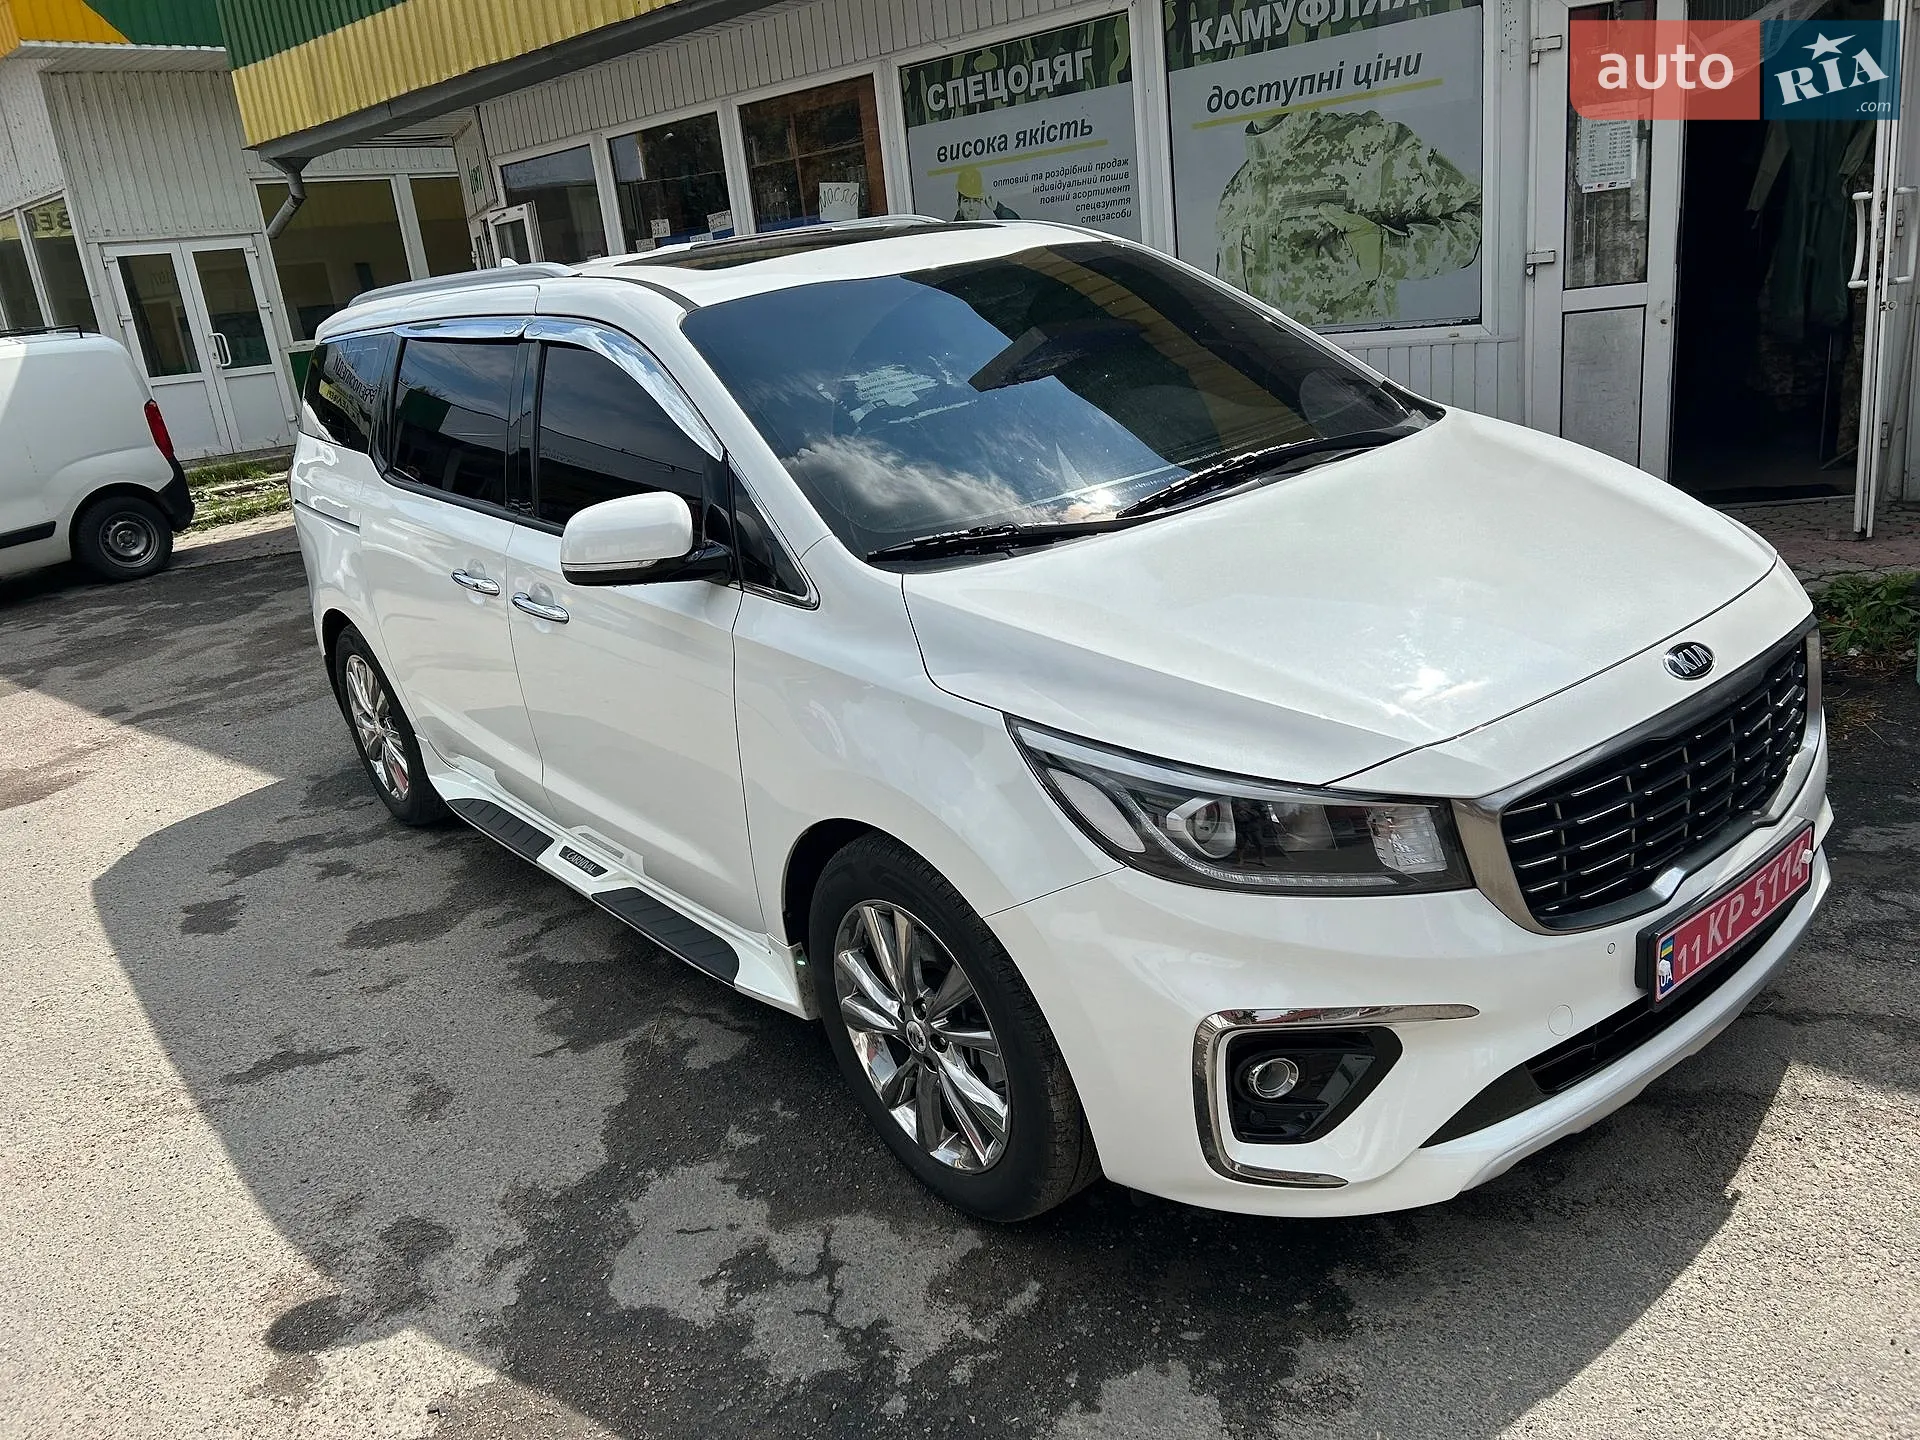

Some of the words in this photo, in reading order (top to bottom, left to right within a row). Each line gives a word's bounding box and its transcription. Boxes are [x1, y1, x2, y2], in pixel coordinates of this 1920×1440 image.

[1191, 0, 1429, 54] КАМУФЛ
[927, 47, 1093, 112] СПЕЦОДЯГ
[1206, 60, 1345, 114] доступні
[1353, 51, 1423, 90] ціни
[937, 133, 1008, 163] висока
[1015, 118, 1093, 149] якість
[993, 173, 1029, 188] оптовий
[1031, 172, 1043, 181] та
[1045, 161, 1093, 181] роздрібний
[1095, 158, 1129, 172] продаж
[1032, 175, 1097, 194] індивідуальний
[1099, 171, 1129, 184] пошив
[1040, 191, 1070, 204] повний
[1072, 184, 1130, 201] асортимент
[1076, 197, 1131, 213] спецвзуття
[1081, 208, 1132, 224] спецзасоби
[1672, 644, 1712, 674] KIA
[1678, 934, 1702, 975] 11
[1707, 893, 1745, 955] KP
[1751, 840, 1806, 918] 5114
